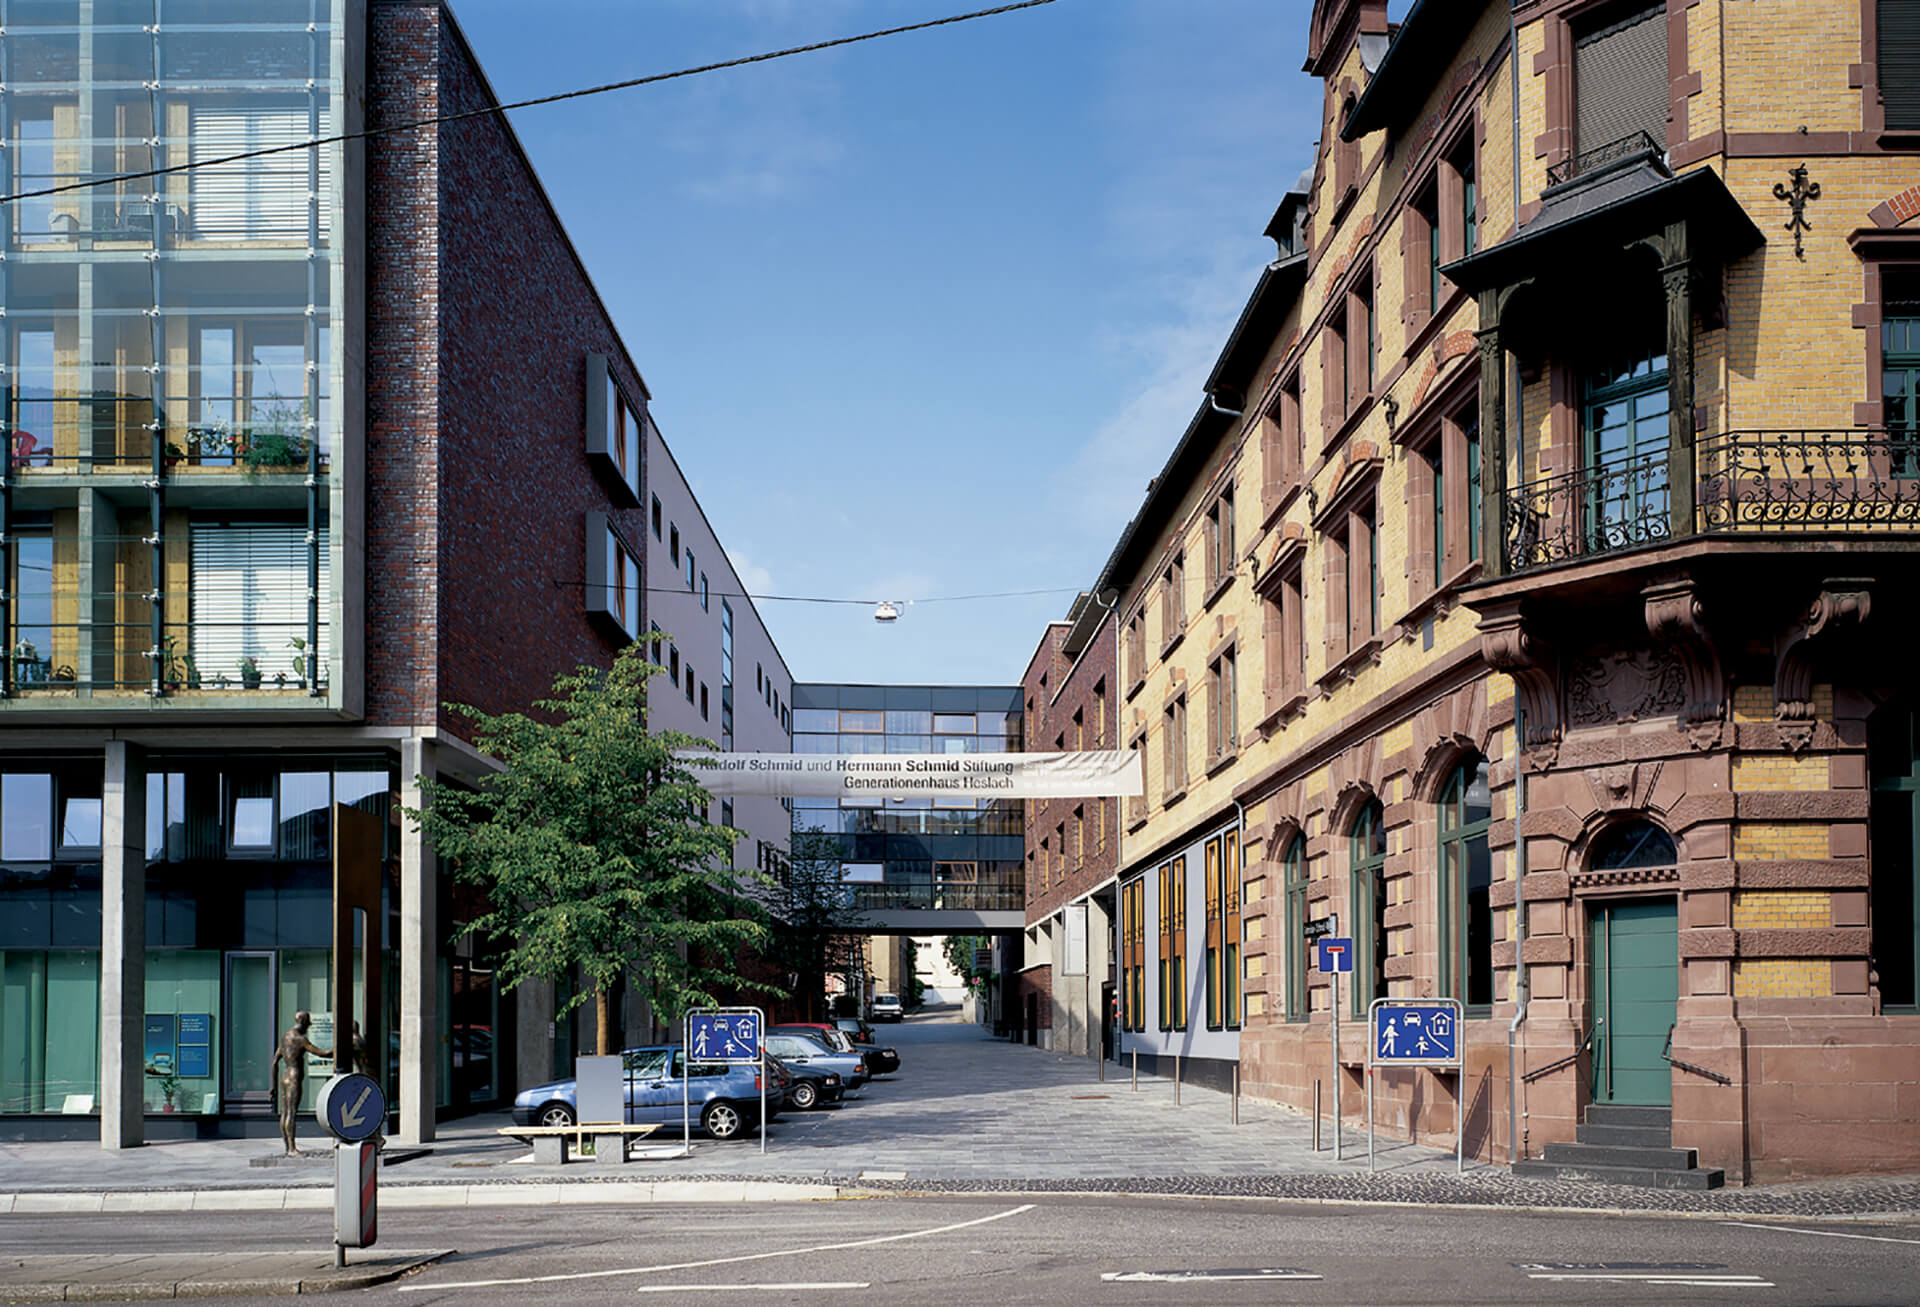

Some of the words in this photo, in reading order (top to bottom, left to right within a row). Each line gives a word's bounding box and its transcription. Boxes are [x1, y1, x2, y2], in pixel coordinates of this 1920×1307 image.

[749, 759, 803, 772] Schmid
[807, 760, 832, 772] und
[836, 760, 901, 772] Hermann
[905, 760, 959, 772] Schmid
[963, 760, 1014, 775] Stiftung
[844, 776, 960, 789] Generationenhaus
[963, 776, 1014, 789] Heslach
